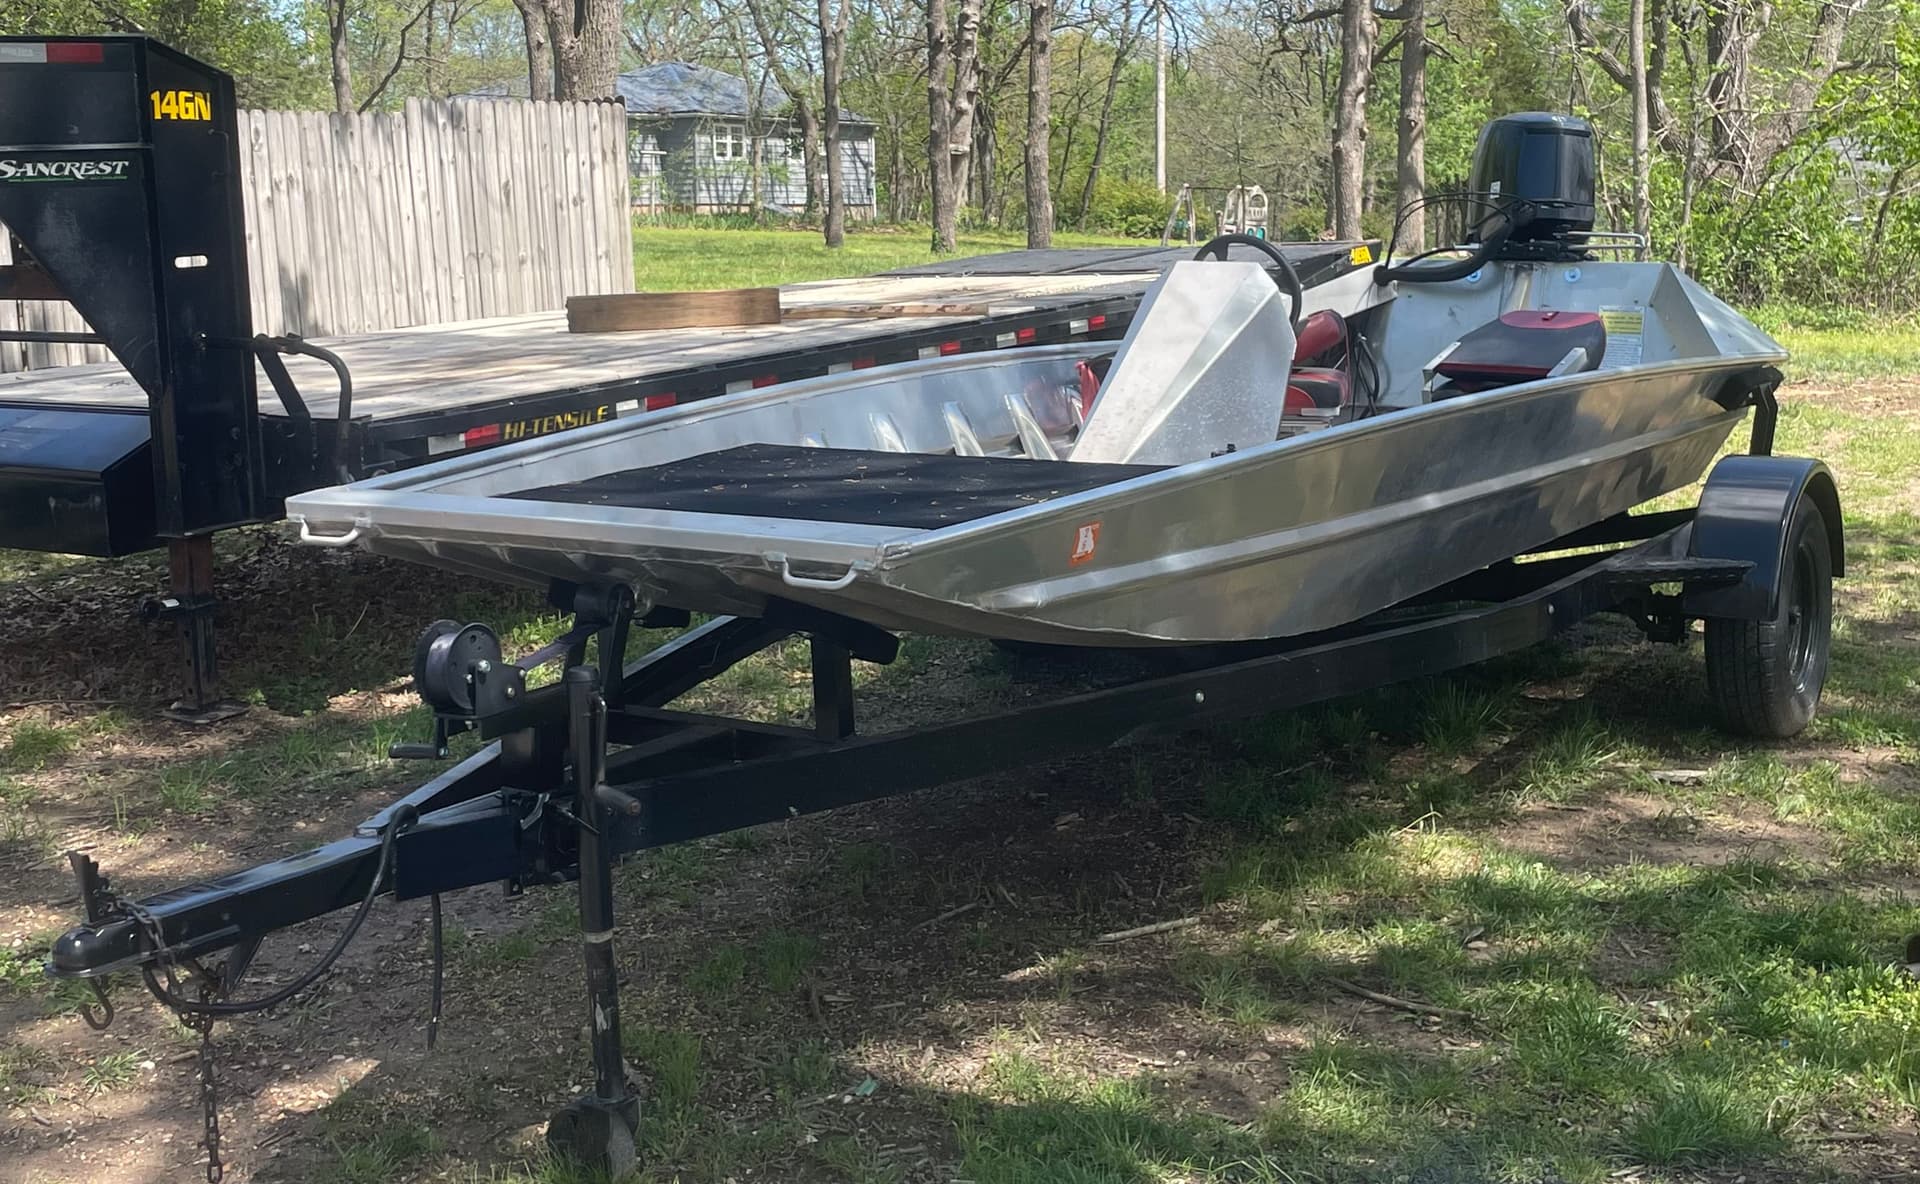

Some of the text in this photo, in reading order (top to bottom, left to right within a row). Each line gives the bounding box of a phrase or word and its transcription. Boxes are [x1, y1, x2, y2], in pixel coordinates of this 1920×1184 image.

[150, 90, 212, 121] 14GN
[0, 160, 129, 179] SANCREST
[504, 405, 609, 440] HI-TENSILE
